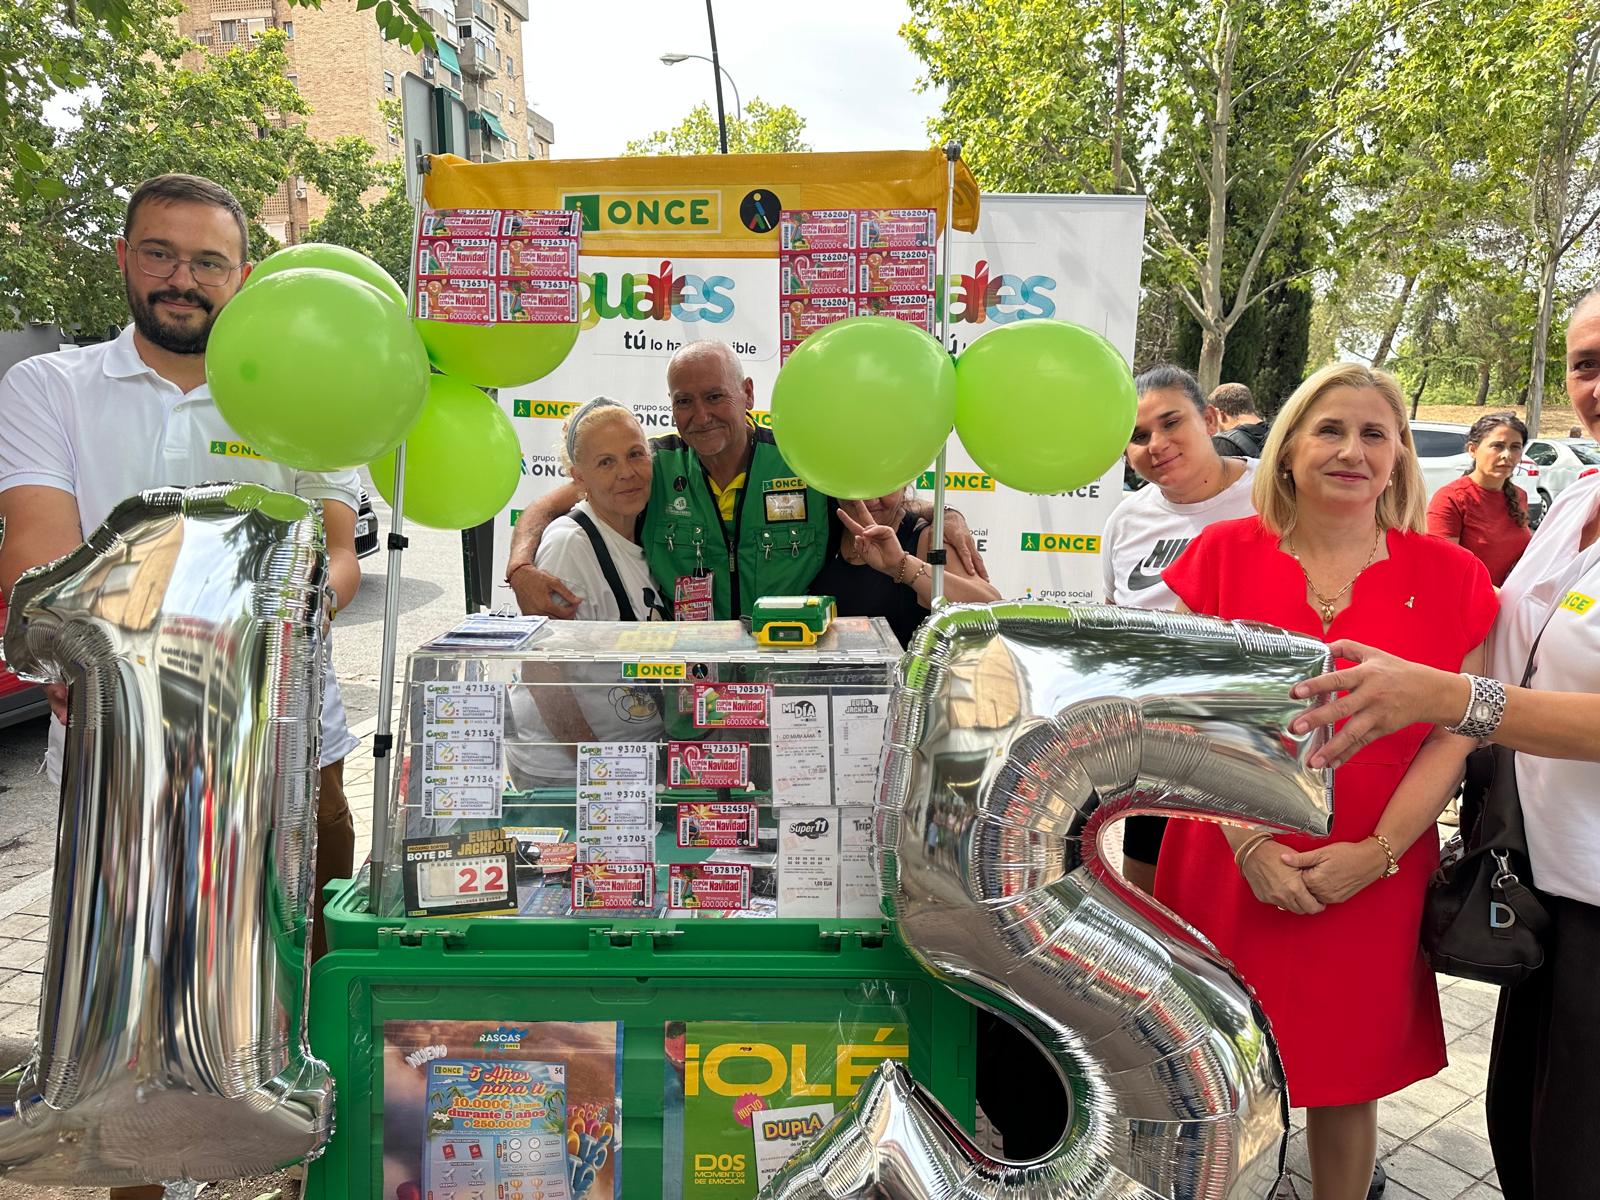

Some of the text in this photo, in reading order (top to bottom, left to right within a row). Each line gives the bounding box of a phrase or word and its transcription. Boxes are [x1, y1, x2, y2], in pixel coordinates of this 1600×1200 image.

[608, 200, 709, 224] ONCE
[818, 224, 847, 234] Navidad
[896, 223, 925, 233] Navidad
[456, 251, 486, 262] Navidad
[536, 252, 566, 262] Navidad
[818, 268, 846, 279] Navidad
[896, 266, 924, 277] Navidad
[456, 294, 486, 306] Navidad
[538, 295, 567, 306] Navidad
[896, 310, 925, 321] Navidad
[624, 330, 646, 350] tú
[650, 338, 662, 350] lo
[733, 340, 756, 354] ible
[534, 404, 575, 416] ONC
[532, 455, 556, 463] grupo
[532, 464, 566, 477] ONC
[775, 480, 803, 488] ONCE
[1044, 536, 1096, 550] ONCE
[1040, 589, 1092, 598] grupo social
[641, 666, 682, 676] ONCE
[733, 701, 762, 711] Navidad
[708, 760, 738, 770] Navidad
[716, 820, 746, 830] Navidad
[853, 820, 872, 832] Trip
[407, 850, 452, 861] BOTE DE
[459, 866, 504, 893] 22
[612, 880, 642, 891] Navidad
[710, 881, 738, 891] Navidad
[480, 1034, 520, 1042] RASCAS
[405, 1044, 448, 1069] NUEVO
[468, 1064, 532, 1084] 5 Años
[478, 1083, 528, 1097] para
[453, 1098, 510, 1110] 10.000€
[448, 1108, 546, 1119] durante 5 años
[738, 1100, 762, 1120] NUEVO
[472, 1120, 530, 1128] 250.000€
[763, 1112, 824, 1140] DUPLA
[695, 1154, 745, 1171] DOS
